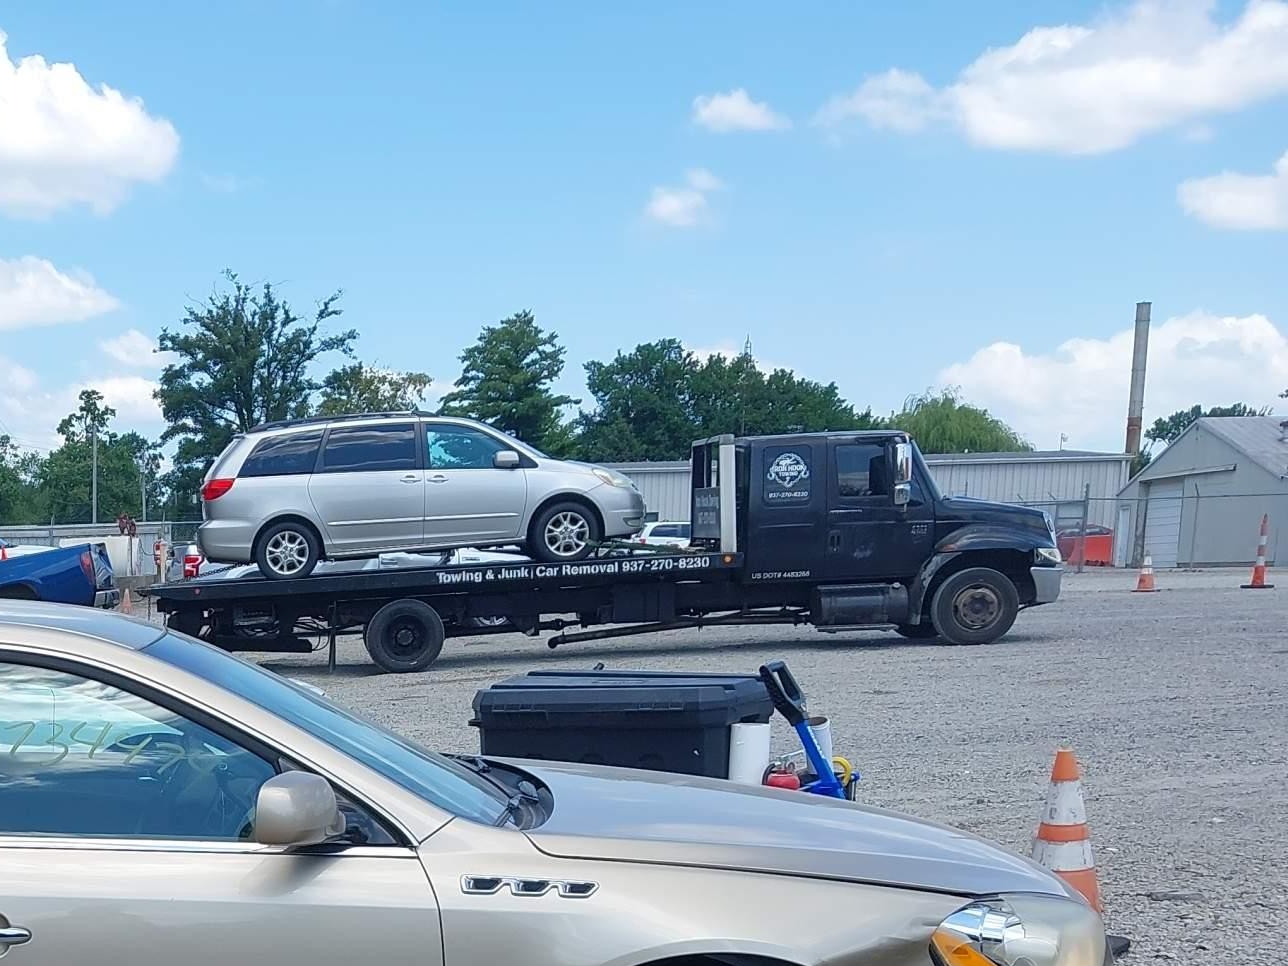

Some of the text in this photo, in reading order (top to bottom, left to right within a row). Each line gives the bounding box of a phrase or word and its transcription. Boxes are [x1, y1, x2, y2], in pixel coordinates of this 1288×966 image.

[436, 556, 710, 584] Towing & Junk Car Removal 937-270-8230
